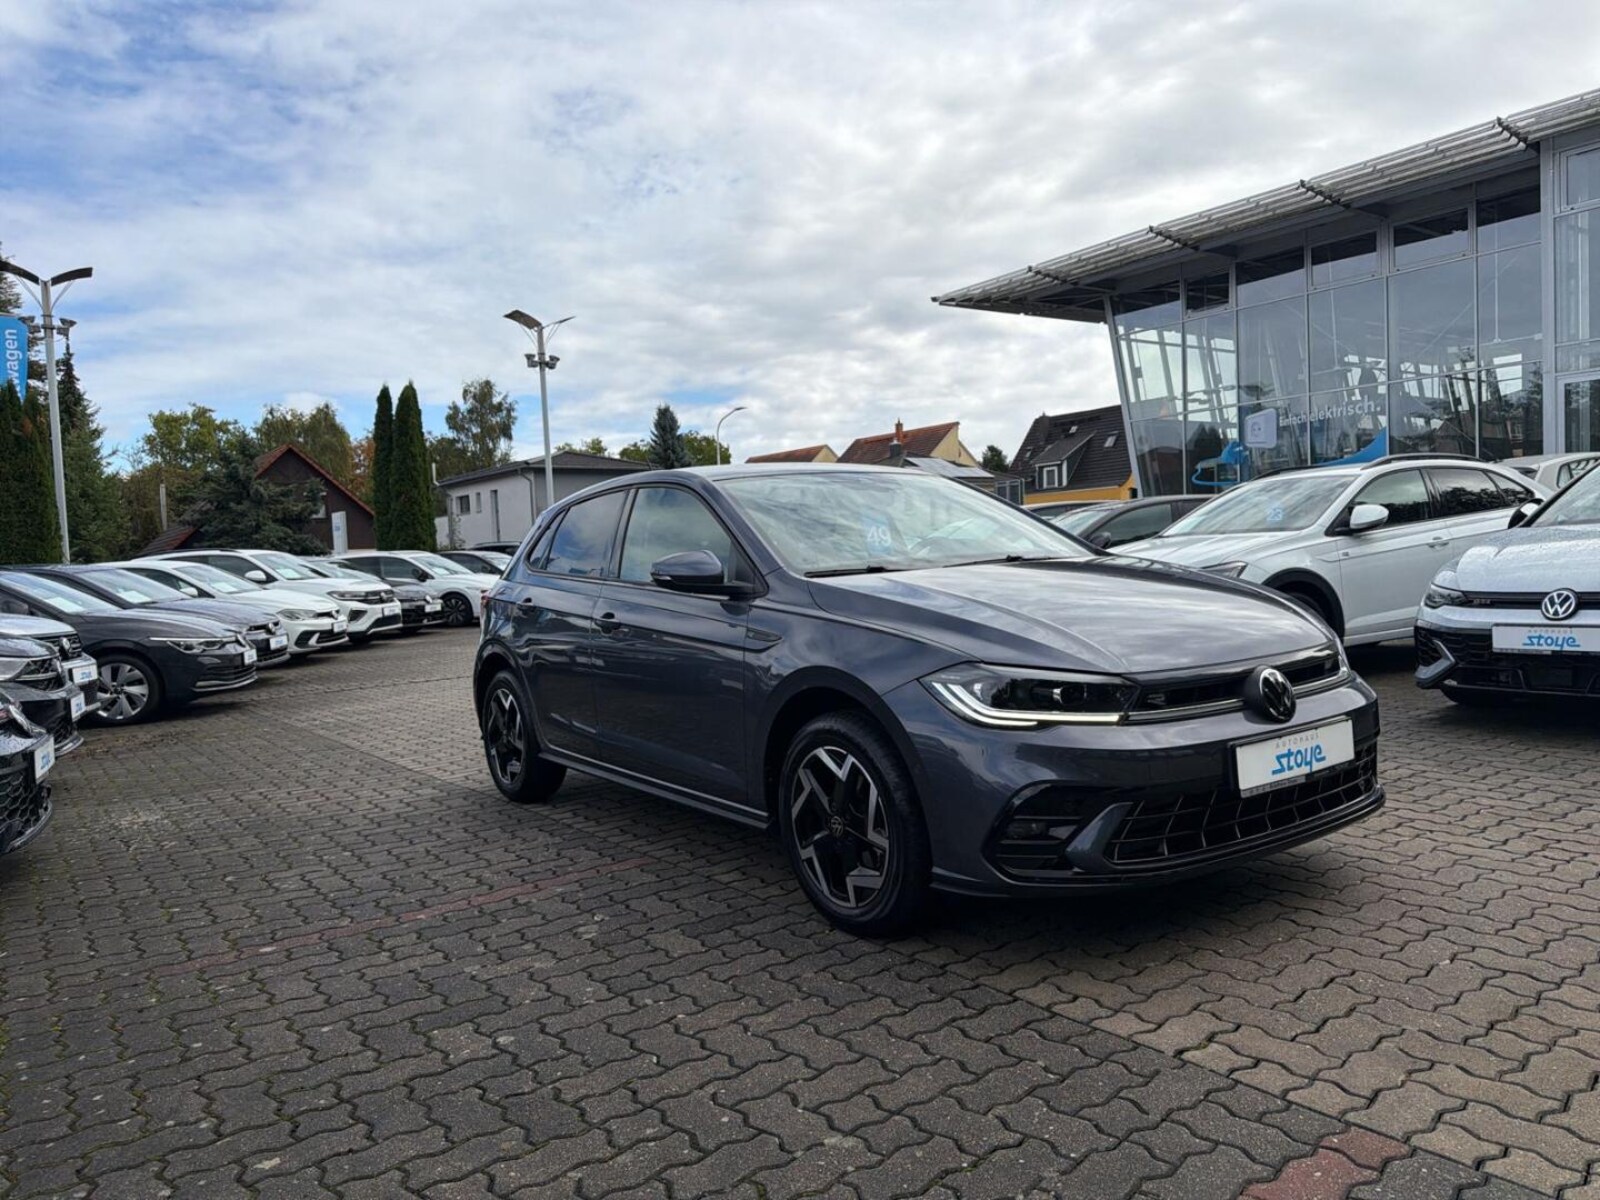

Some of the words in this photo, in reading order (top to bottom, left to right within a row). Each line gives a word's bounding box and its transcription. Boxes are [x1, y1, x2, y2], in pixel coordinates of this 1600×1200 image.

[4, 329, 23, 390] wagen
[1310, 395, 1382, 422] elektrisch.
[1275, 732, 1320, 750] AUTOHAUS
